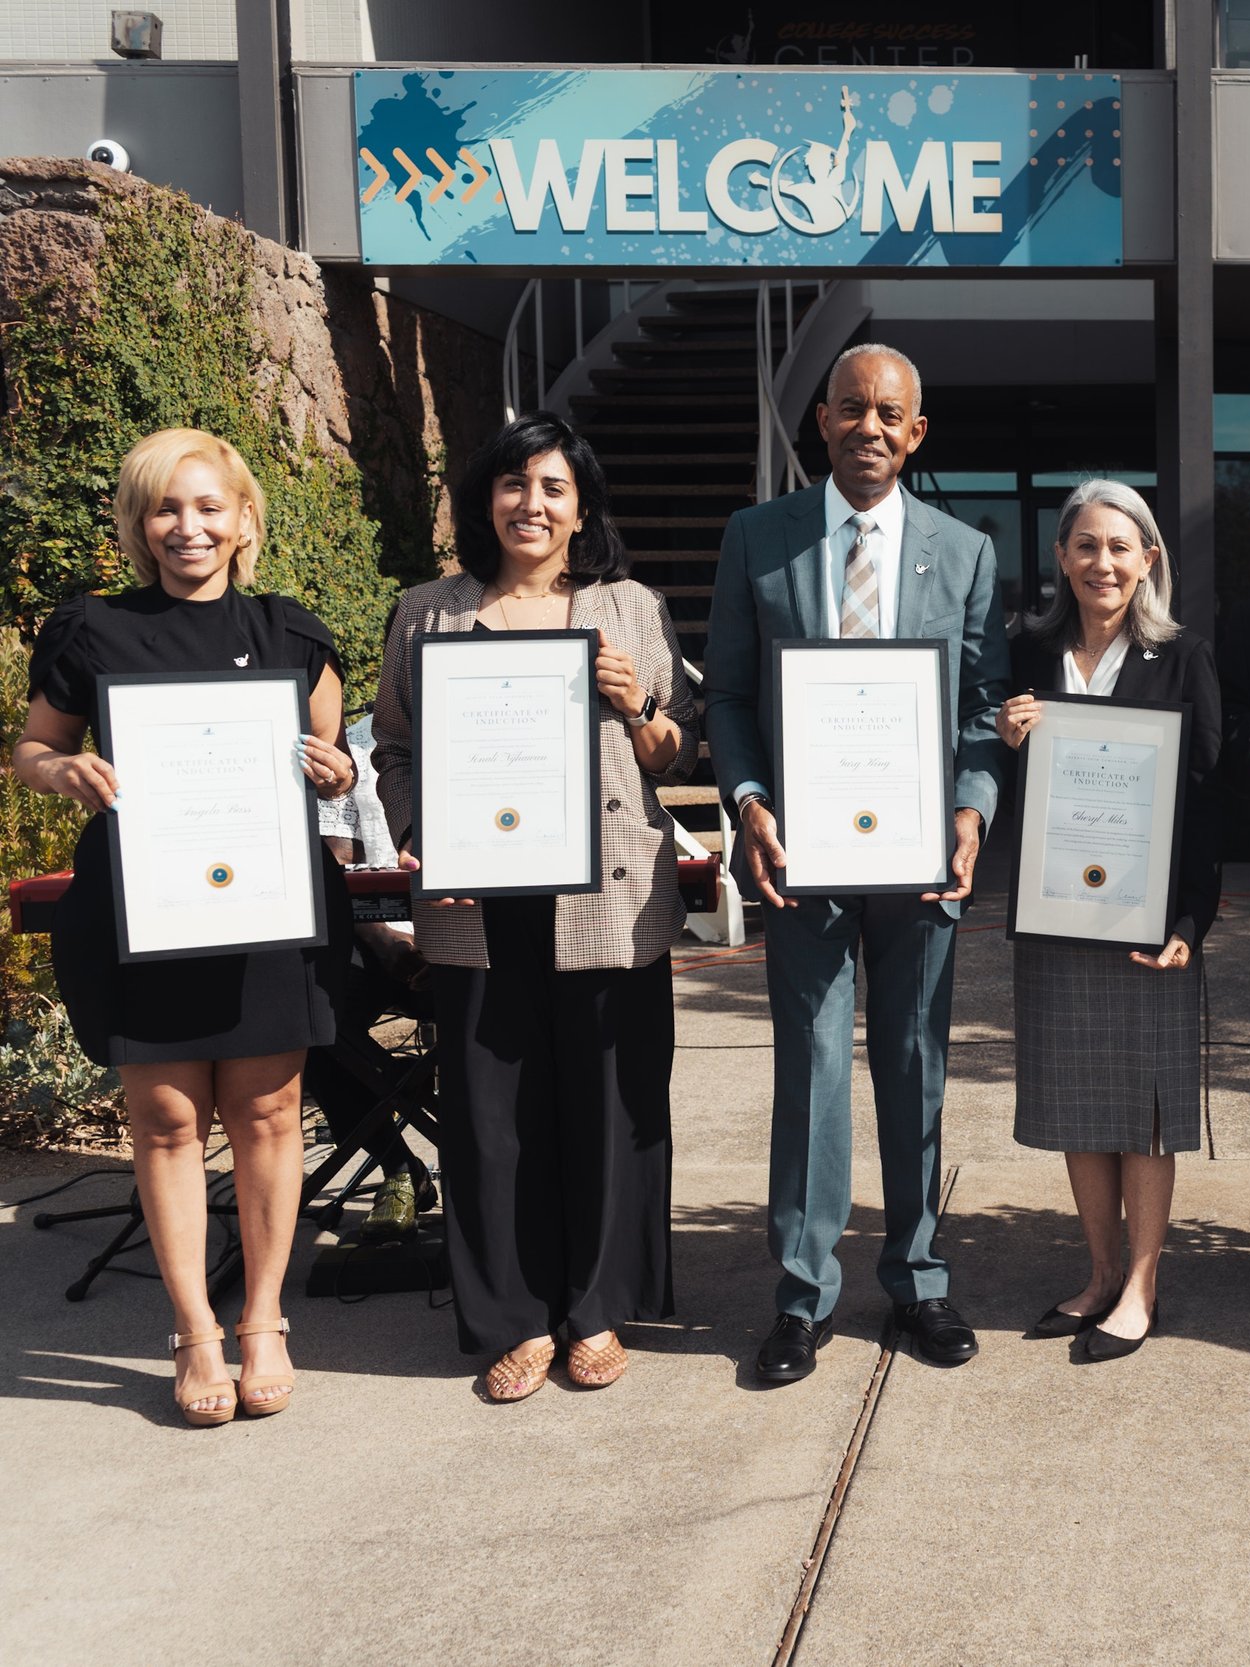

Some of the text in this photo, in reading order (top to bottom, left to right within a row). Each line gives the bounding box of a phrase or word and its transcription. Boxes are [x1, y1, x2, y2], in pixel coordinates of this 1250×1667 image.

[776, 21, 977, 41] COLLEGE SUCCESS
[489, 137, 1004, 236] WELCOME
[461, 707, 549, 719] CERTIFICATE OF
[475, 717, 537, 725] INDUCTION
[839, 758, 862, 773] Gary
[1062, 769, 1142, 783] CERTIFICATE OF
[1073, 777, 1129, 789] INDUCTION
[1071, 810, 1128, 827] Cheryl Miles
